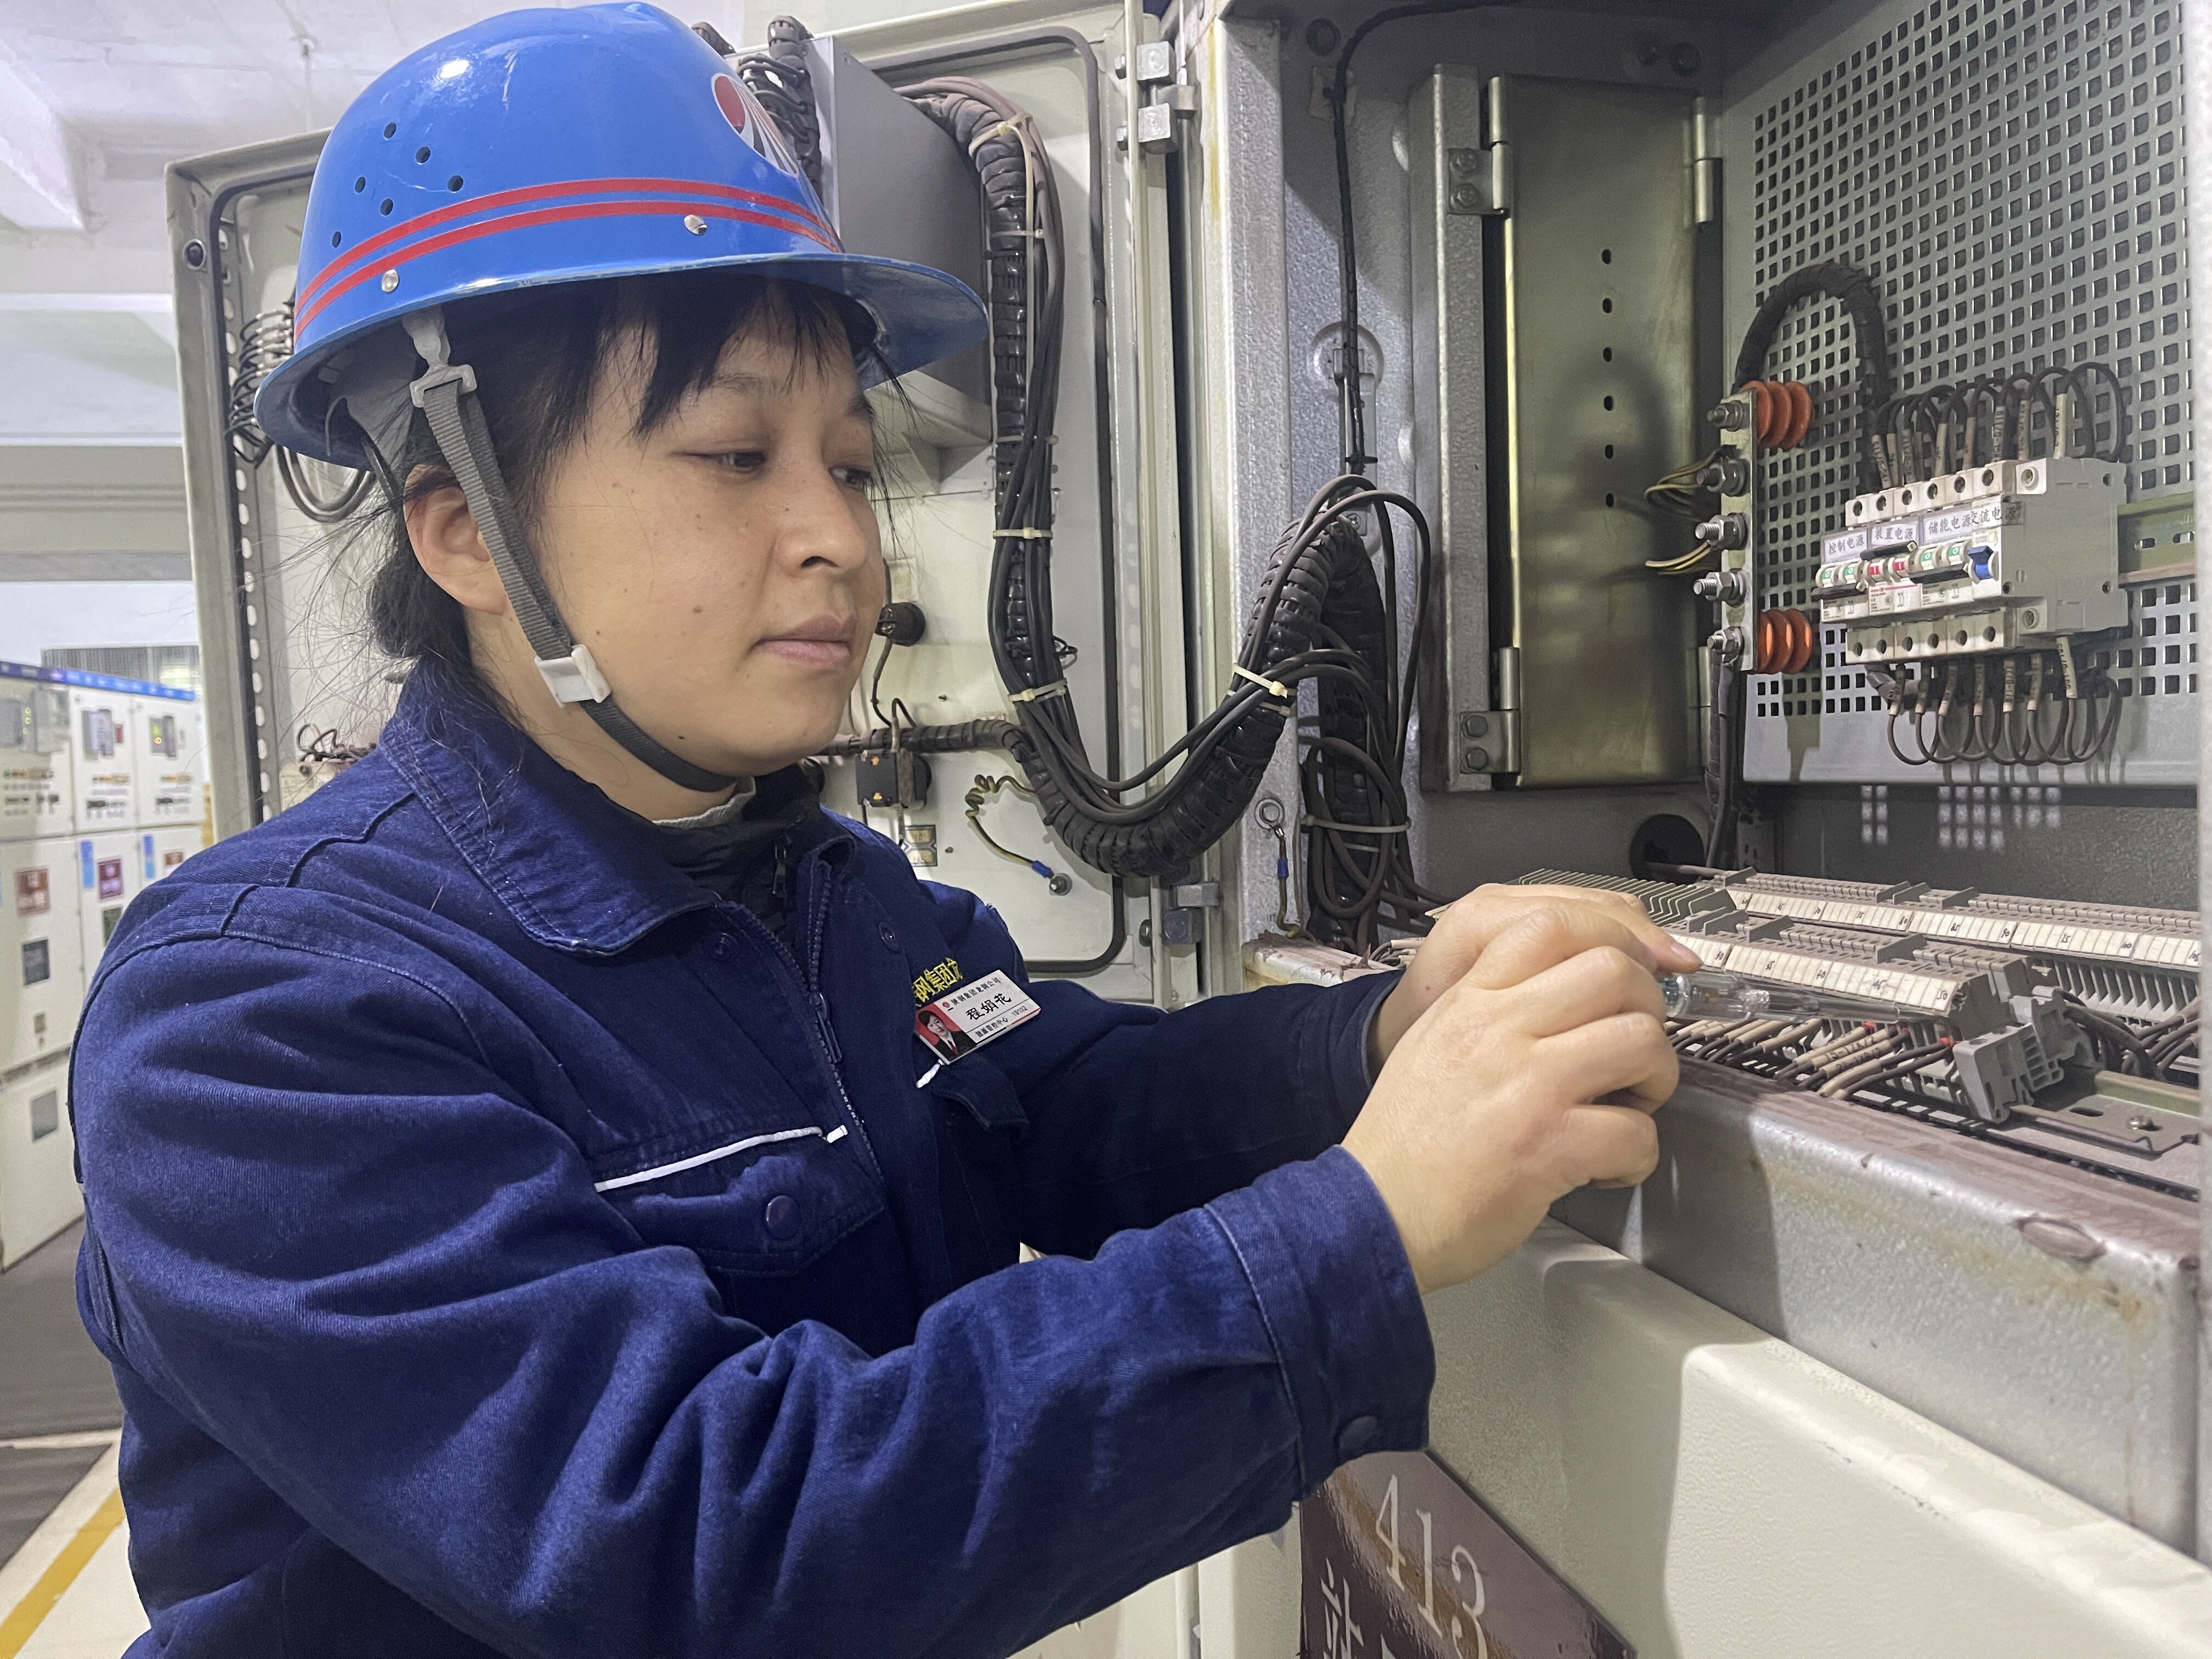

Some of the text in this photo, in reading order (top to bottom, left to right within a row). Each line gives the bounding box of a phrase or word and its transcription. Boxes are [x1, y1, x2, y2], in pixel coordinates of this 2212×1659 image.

[1874, 527, 1914, 541] 装置电源
[1928, 514, 1972, 535] 储能电源
[1828, 535, 1865, 555] 控制电源
[1899, 916, 1908, 926] 80
[1950, 923, 1960, 932] 85
[2001, 928, 2010, 938] 90
[911, 957, 963, 1007] 钢集团
[1936, 990, 1948, 1001] 50
[965, 993, 1012, 1020] 程娟花
[1375, 1474, 1487, 1659] 413
